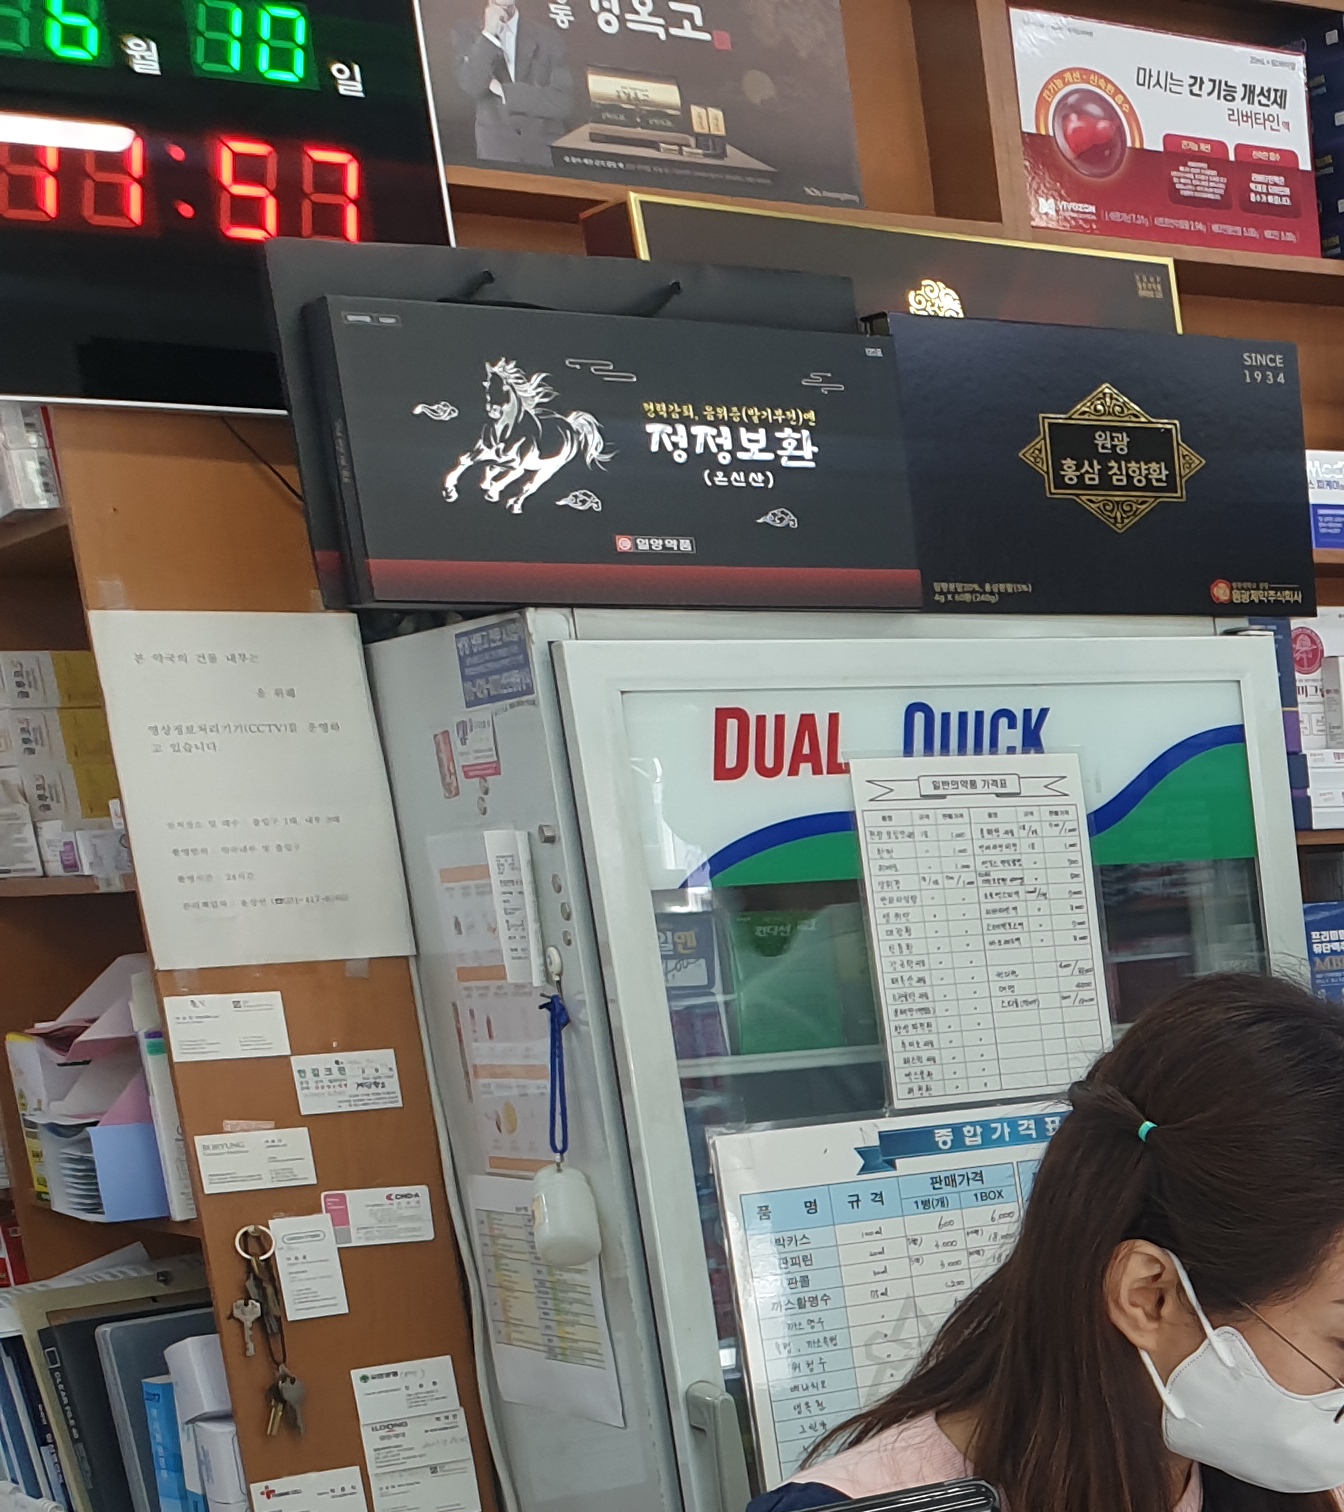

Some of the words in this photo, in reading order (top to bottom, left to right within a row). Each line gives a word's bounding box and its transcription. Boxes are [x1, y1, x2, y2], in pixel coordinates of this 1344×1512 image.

[125, 37, 161, 76] 월
[331, 61, 366, 97] 일
[1136, 66, 1185, 95] 마시는
[1188, 75, 1206, 98] 간
[1207, 78, 1238, 102] 기능
[1240, 82, 1289, 110] 개선제
[1227, 107, 1281, 132] 리버타인
[1242, 352, 1284, 368] SINCE
[1244, 369, 1286, 384] 1934
[645, 422, 820, 469] 정정보환
[1093, 431, 1131, 455] 원광
[704, 469, 775, 489] (온신산)
[1060, 459, 1102, 486] 홍삼
[1107, 460, 1170, 487] 침향환
[636, 537, 693, 552] 일양약품
[712, 706, 851, 782] DUAL
[903, 701, 1052, 758] QUICK
[930, 1171, 985, 1190] 판매가격
[973, 1189, 1005, 1204] 1BOX
